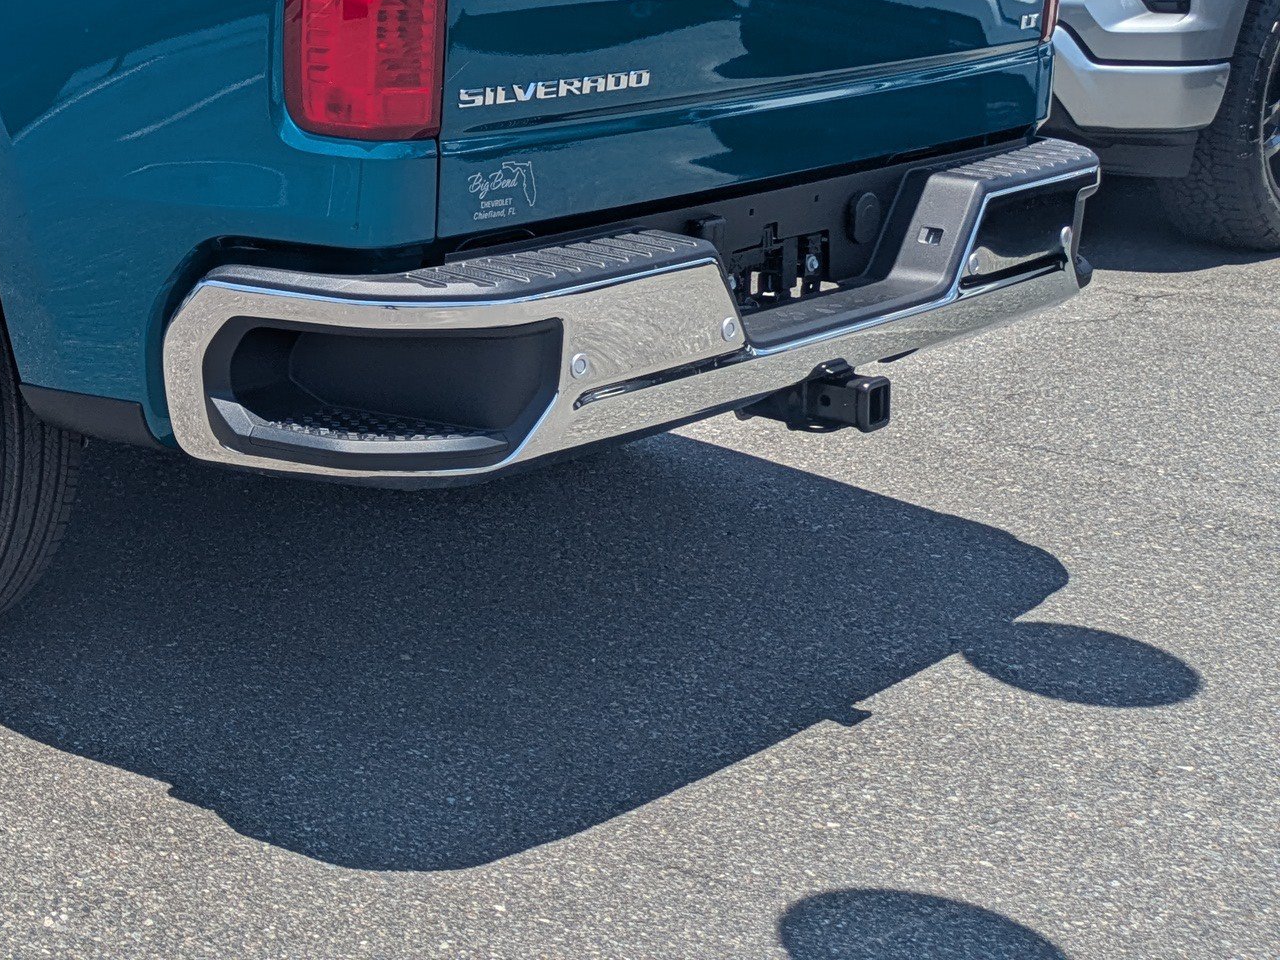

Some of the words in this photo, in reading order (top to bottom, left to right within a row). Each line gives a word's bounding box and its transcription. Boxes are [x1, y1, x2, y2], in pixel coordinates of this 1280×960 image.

[1021, 13, 1039, 30] LT
[458, 68, 651, 109] SILVERADO
[467, 172, 491, 200] Big
[488, 169, 520, 191] Bend
[480, 197, 513, 209] CHEVROLET
[507, 207, 516, 216] FL
